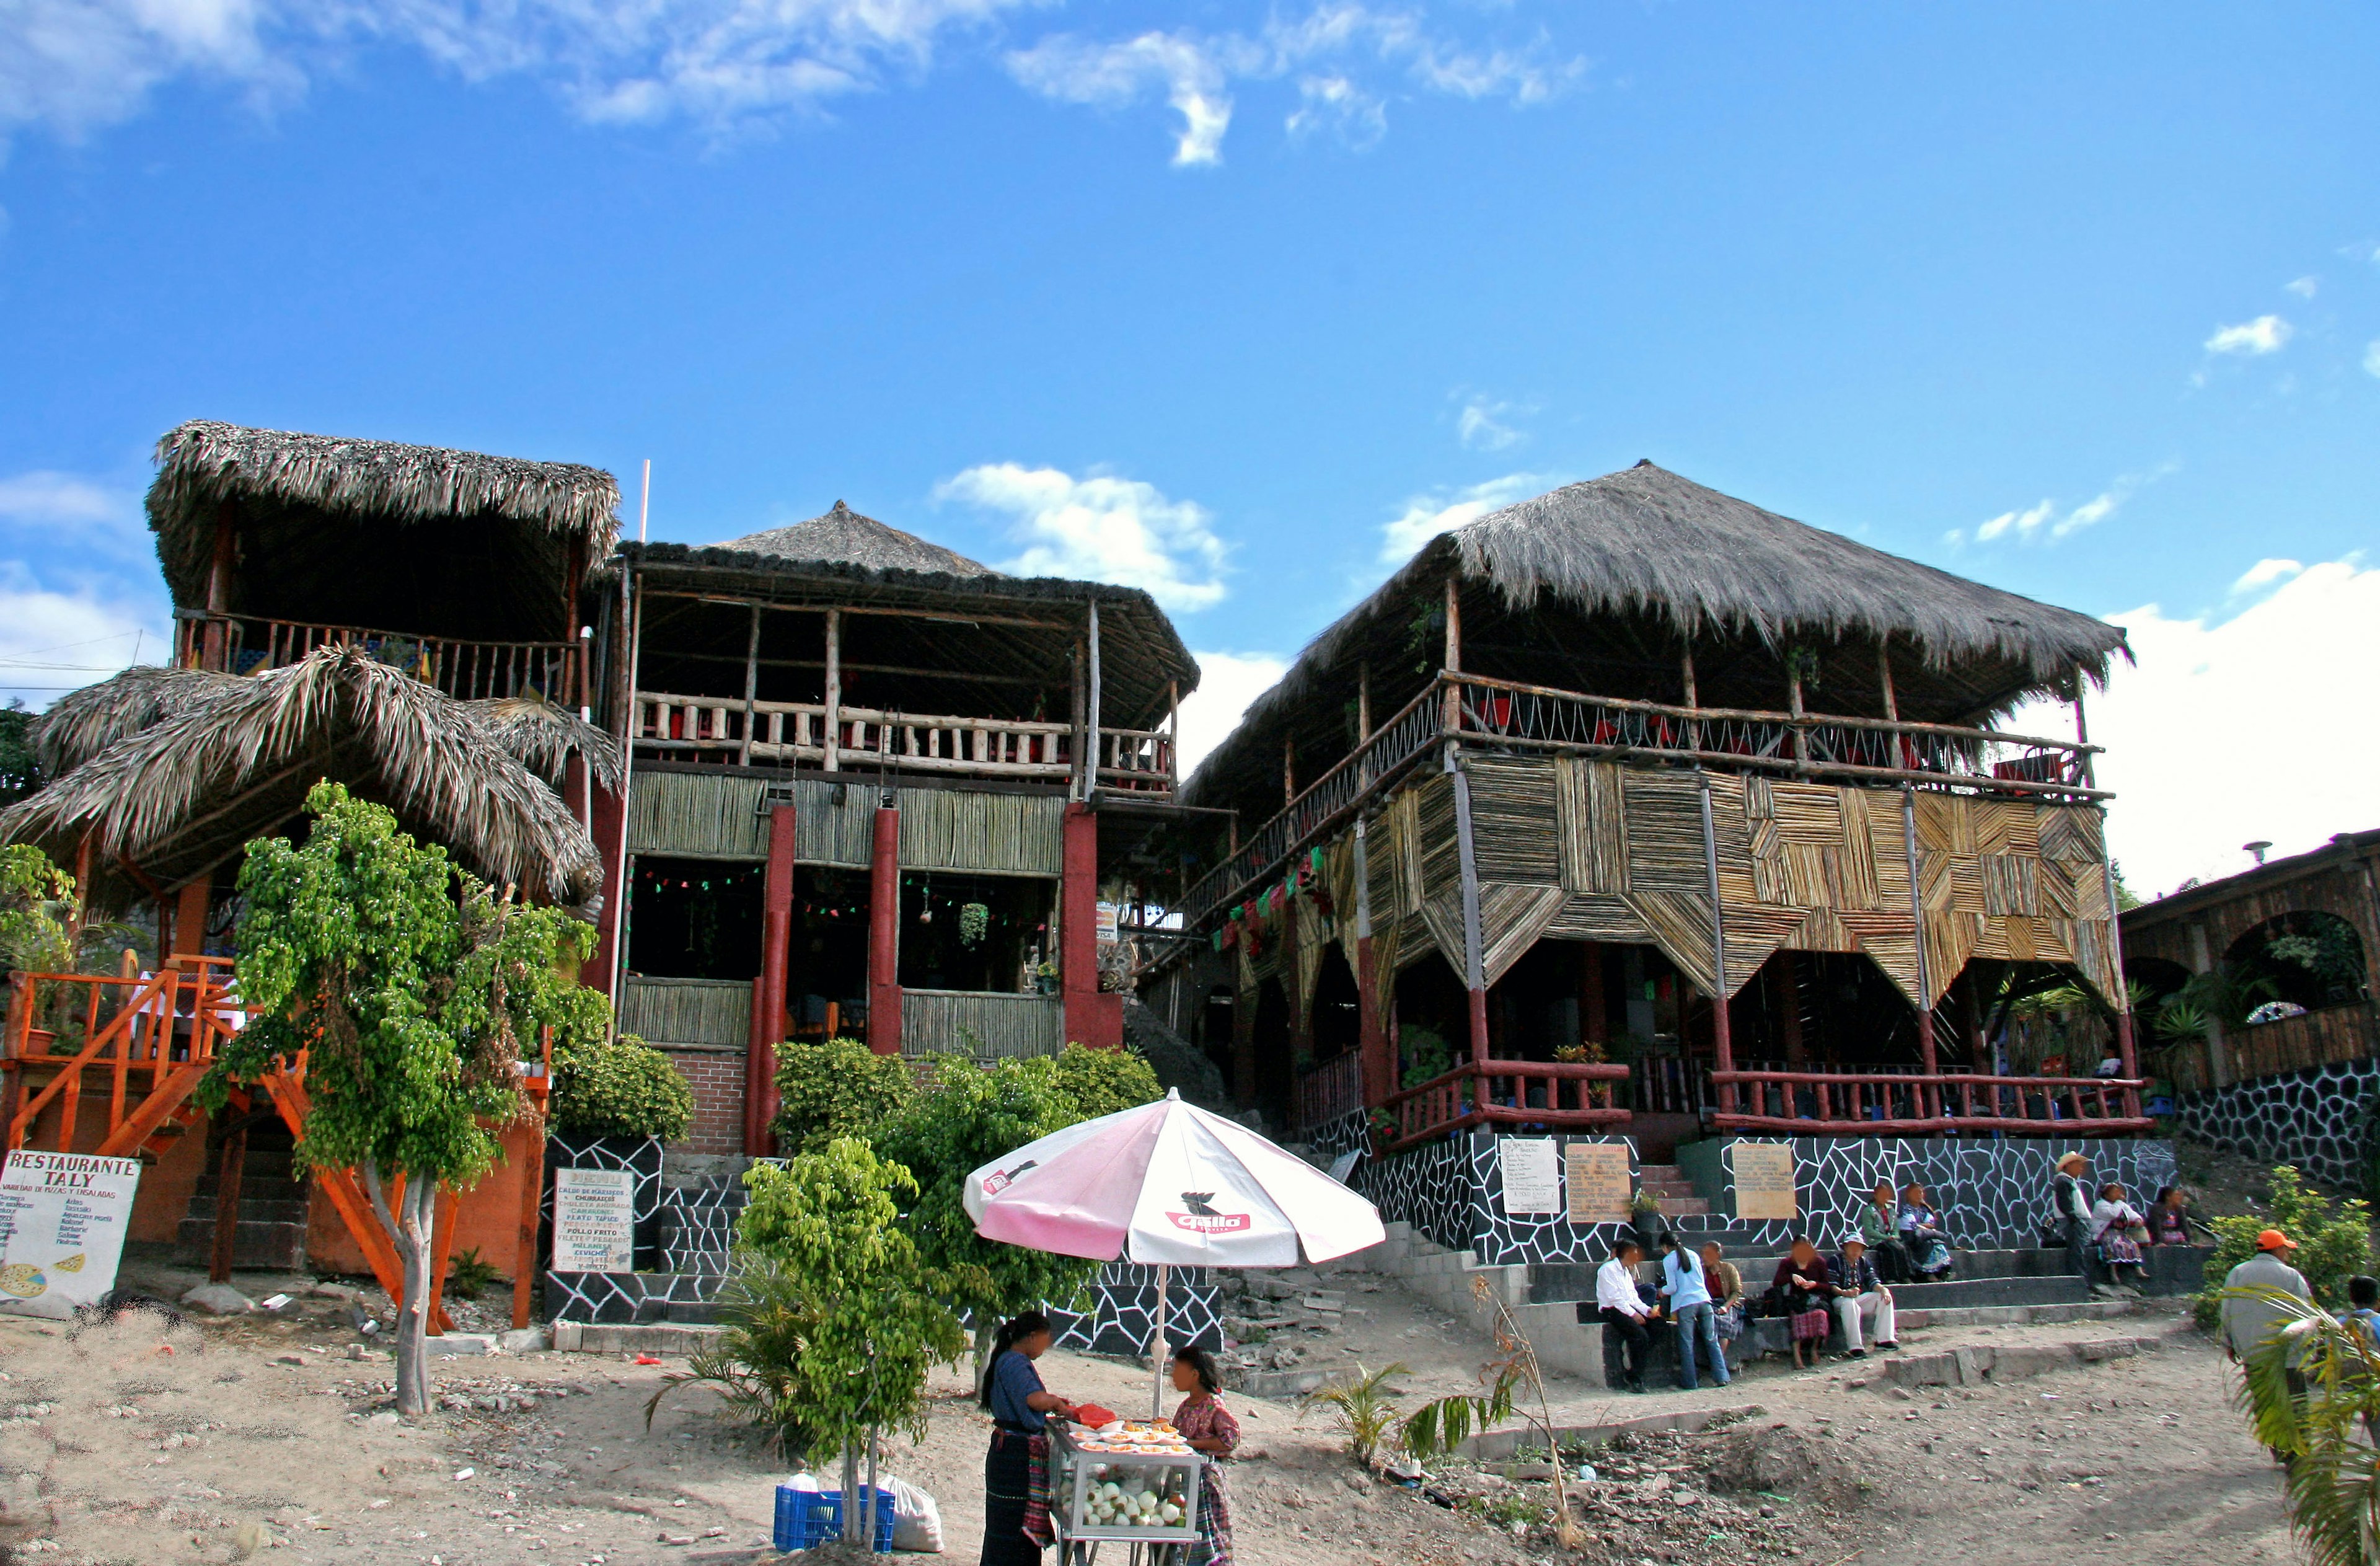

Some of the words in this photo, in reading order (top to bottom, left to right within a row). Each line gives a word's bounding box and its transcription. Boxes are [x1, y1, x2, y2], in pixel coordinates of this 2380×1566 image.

[9, 1153, 136, 1176] RESTAURANTE
[44, 1171, 95, 1188] TALY
[2, 1183, 32, 1192] VARIEDAD
[77, 1188, 116, 1199] ENSALADAS
